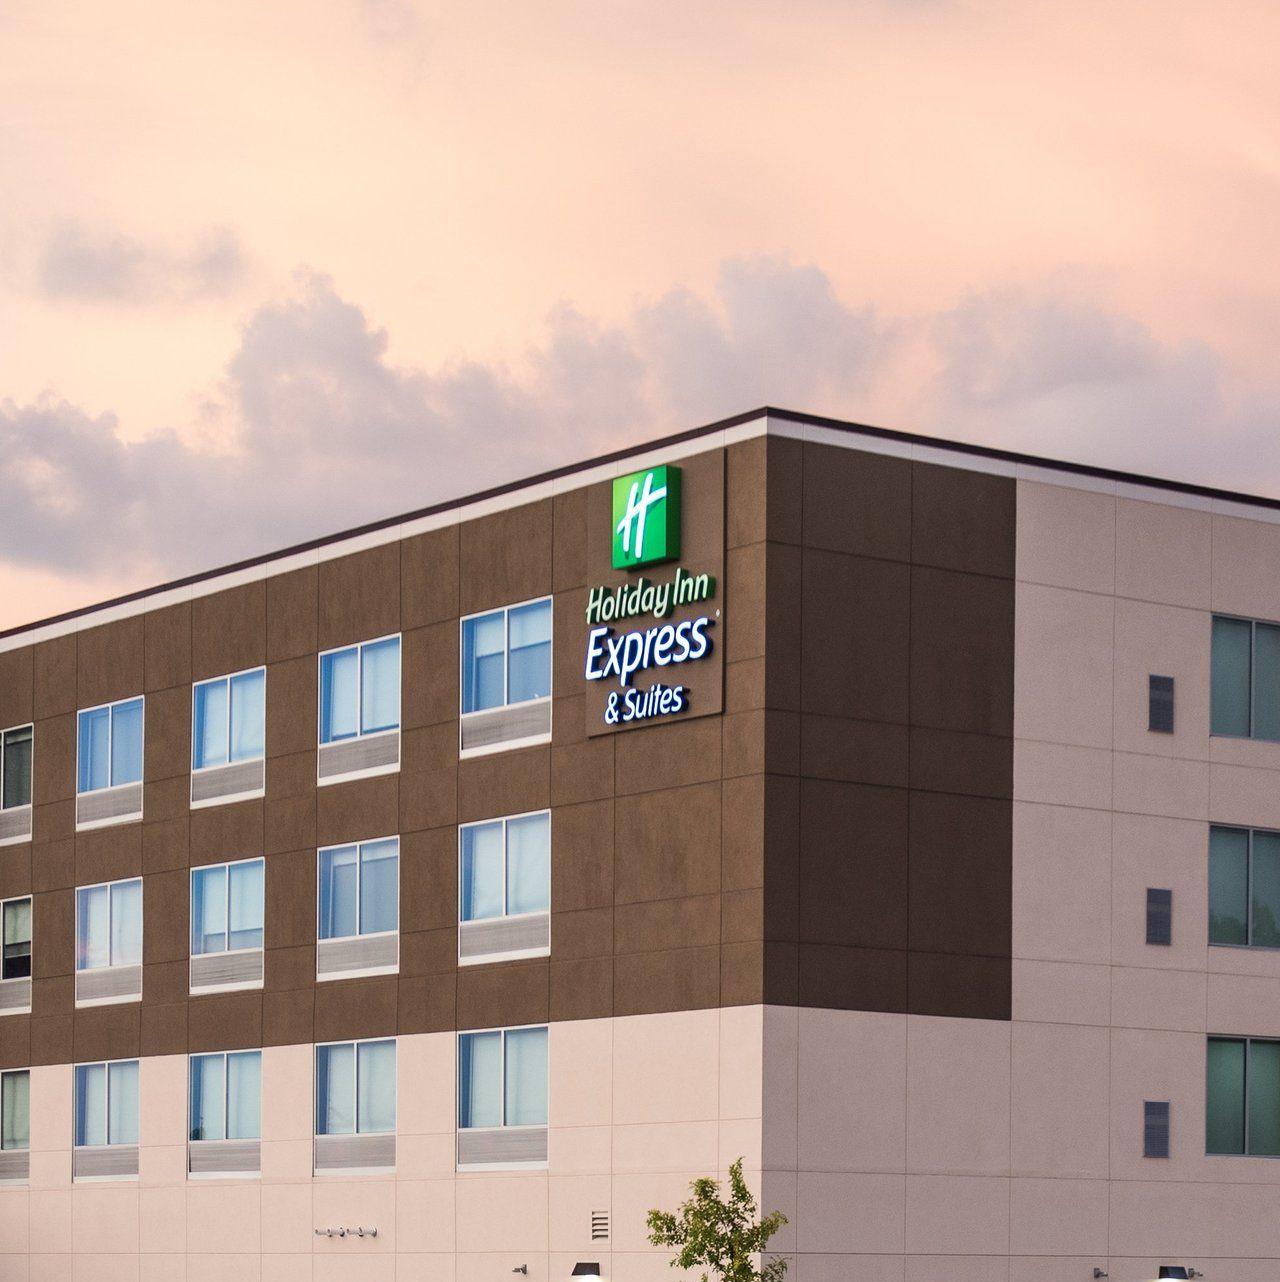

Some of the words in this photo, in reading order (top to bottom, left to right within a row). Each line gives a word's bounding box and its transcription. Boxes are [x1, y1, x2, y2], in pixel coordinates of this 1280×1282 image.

[585, 577, 670, 625] Holiday
[673, 567, 709, 605] Inn
[585, 617, 709, 687] Express
[604, 691, 619, 725] &
[622, 683, 684, 721] Suites
